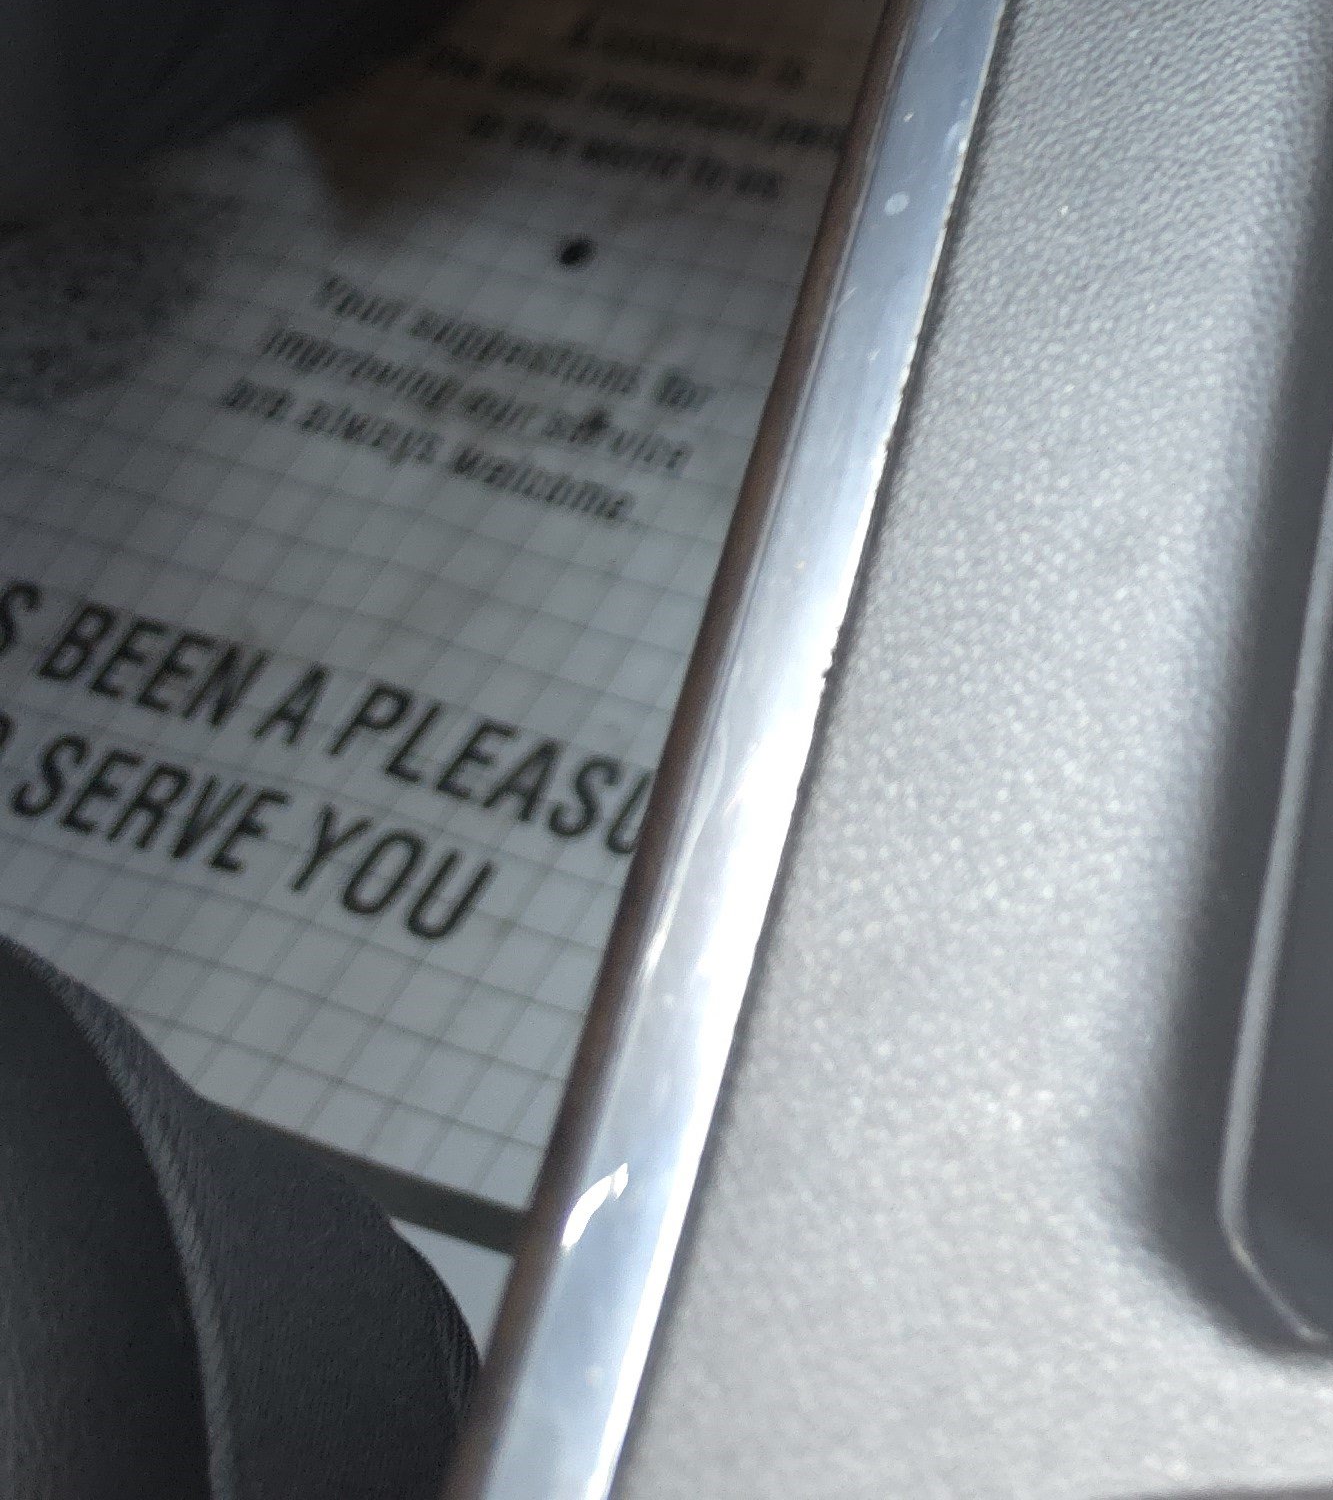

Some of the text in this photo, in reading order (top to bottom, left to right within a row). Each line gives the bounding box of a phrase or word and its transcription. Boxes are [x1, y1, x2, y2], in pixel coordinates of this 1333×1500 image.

[260, 325, 694, 474] improving our service
[316, 272, 716, 414] Your suggestions for
[222, 376, 292, 423] are
[296, 396, 444, 470] always
[37, 600, 272, 728] BEEN
[253, 662, 332, 747] A
[9, 732, 499, 942] SERVE YOU
